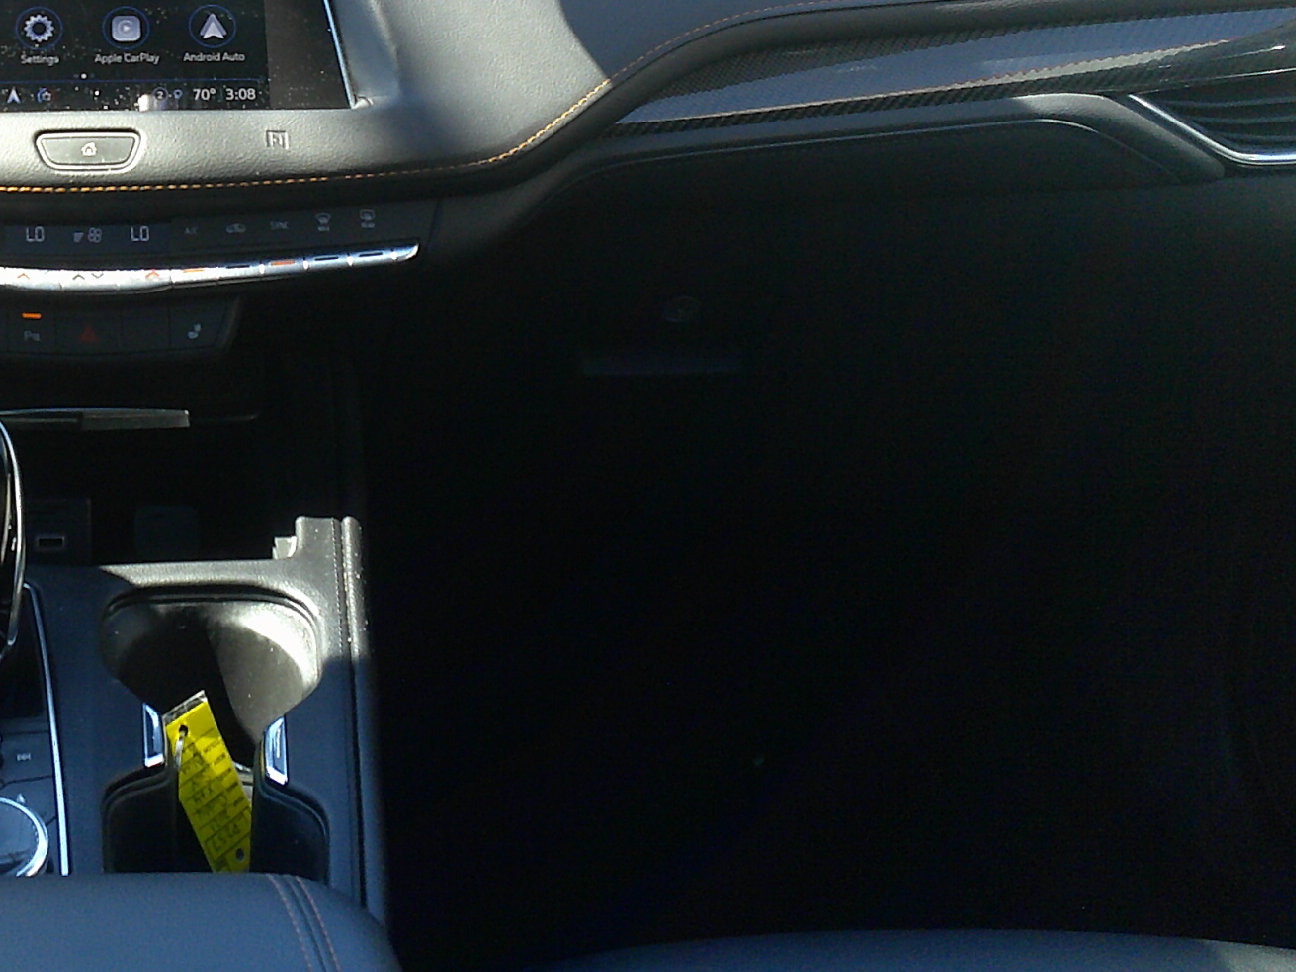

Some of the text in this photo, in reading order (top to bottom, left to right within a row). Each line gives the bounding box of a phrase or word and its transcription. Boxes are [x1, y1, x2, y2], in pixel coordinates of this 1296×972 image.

[20, 54, 59, 66] Settings
[94, 53, 160, 65] Apple CarPlay
[183, 52, 245, 62] Android Auto
[193, 88, 217, 101] 70°
[225, 88, 256, 101] 3:08
[26, 226, 45, 242] LO
[130, 225, 150, 242] LO
